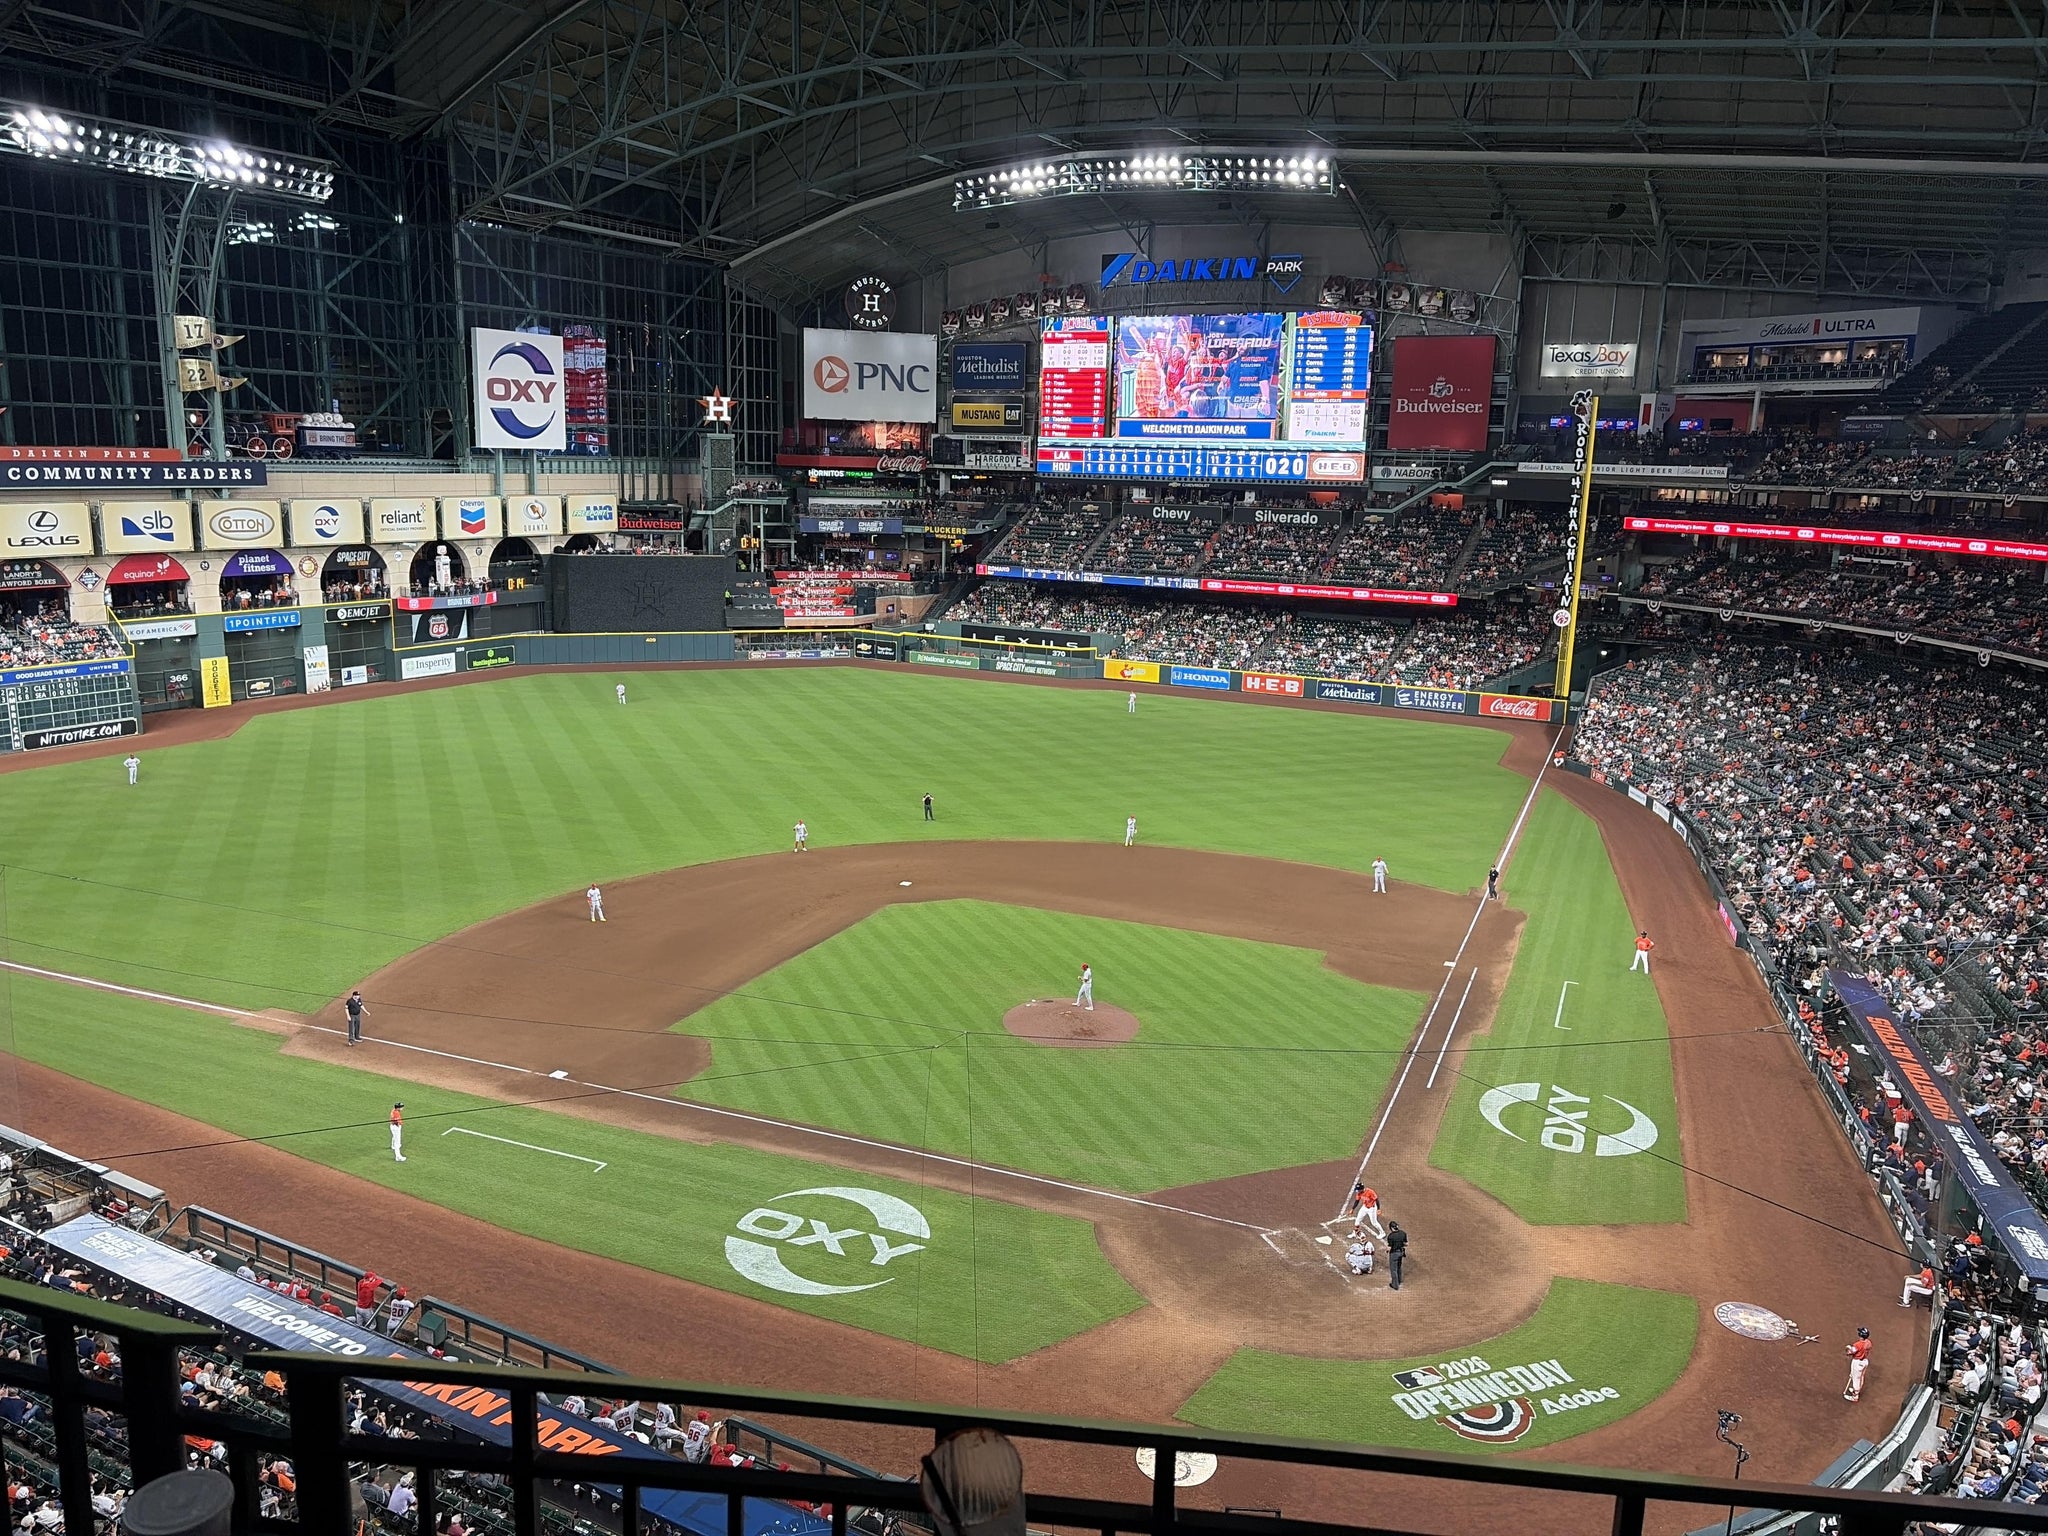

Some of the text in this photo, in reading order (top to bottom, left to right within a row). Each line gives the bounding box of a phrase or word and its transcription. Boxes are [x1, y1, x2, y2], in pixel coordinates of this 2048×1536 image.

[1131, 257, 1303, 283] DAIKIN PARK
[852, 277, 891, 293] HOUSTON
[863, 294, 880, 312] H
[942, 310, 958, 325] 32
[966, 304, 982, 319] 40
[852, 314, 889, 328] ASTROS
[1306, 311, 1351, 326] ASTROS
[184, 324, 203, 339] 17
[1760, 319, 1876, 338] Michelob ULTRA
[1549, 347, 1630, 367] Texas Bay
[957, 358, 1020, 373] Methodist
[188, 368, 207, 382] 22
[853, 361, 930, 392] PNC
[487, 377, 557, 403] OXY
[961, 409, 1020, 420] MUSTANG CAT
[1142, 425, 1246, 435] WELCOME TO DAIKIN PARK
[319, 435, 345, 443] BRING THE
[13, 449, 151, 459] DAIKIN PARK
[1053, 451, 1070, 459] LAA
[974, 455, 1022, 467] HARGROVE
[1052, 462, 1071, 471] HOU
[1266, 457, 1303, 475] 0 2 0
[8, 467, 253, 480] COMMUNITY LEADERS
[808, 469, 845, 477] HORNITOS
[460, 499, 485, 507] Chevron
[381, 510, 422, 524] reliant
[572, 505, 613, 521] FREEPORT LNG
[1152, 507, 1191, 521] Chevy
[1255, 510, 1318, 525] Silverado
[1560, 423, 1588, 607] ROOT 4 THA CHIKIN
[143, 510, 173, 530] slb
[218, 516, 265, 532] COTTON
[315, 518, 339, 526] OXY
[619, 517, 683, 529] Budweiser
[924, 526, 967, 534] PLUCKERS
[7, 535, 80, 547] LEXUS
[238, 554, 270, 565] planet
[336, 551, 372, 562] SPACE CITY
[243, 563, 276, 573] fitness
[3, 571, 42, 579] LANDRY'S
[123, 571, 155, 580] equinor
[798, 571, 899, 580] Budweiser Budweiser
[1067, 571, 1074, 581] K
[35, 578, 56, 586] BOXES
[347, 606, 380, 618] EMCJET
[229, 614, 296, 628] 1POINTFIVE
[146, 626, 178, 634] AMERICA
[432, 624, 445, 633] 66
[307, 661, 326, 669] WM
[416, 657, 451, 670] Insperity
[924, 655, 945, 663] National
[996, 661, 1012, 671] SPACE
[1012, 663, 1025, 672] CITY
[15, 672, 34, 680] GOOD
[34, 670, 53, 678] LEADS
[169, 674, 188, 683] 366
[211, 660, 220, 701] DOGGETT
[1183, 673, 1229, 684] HONDA
[1246, 676, 1300, 693] H-E-B
[1320, 686, 1376, 701] Methodist
[1414, 691, 1454, 701] ENERGY
[1414, 699, 1463, 711] TRANSFER
[40, 723, 122, 746] NITTOTIRE.COM
[1866, 1016, 1962, 1123] HOUSTON ASTROS
[1540, 1084, 1590, 1153] OXY
[1945, 1124, 2001, 1187] HOME OF THE
[736, 1207, 926, 1266] OXY
[392, 1308, 404, 1317] 20
[232, 1299, 367, 1356] WELCOME TO
[1439, 1355, 1492, 1379] 2026
[1391, 1359, 1575, 1420] OPENING DAY
[1540, 1386, 1621, 1415] Adobe
